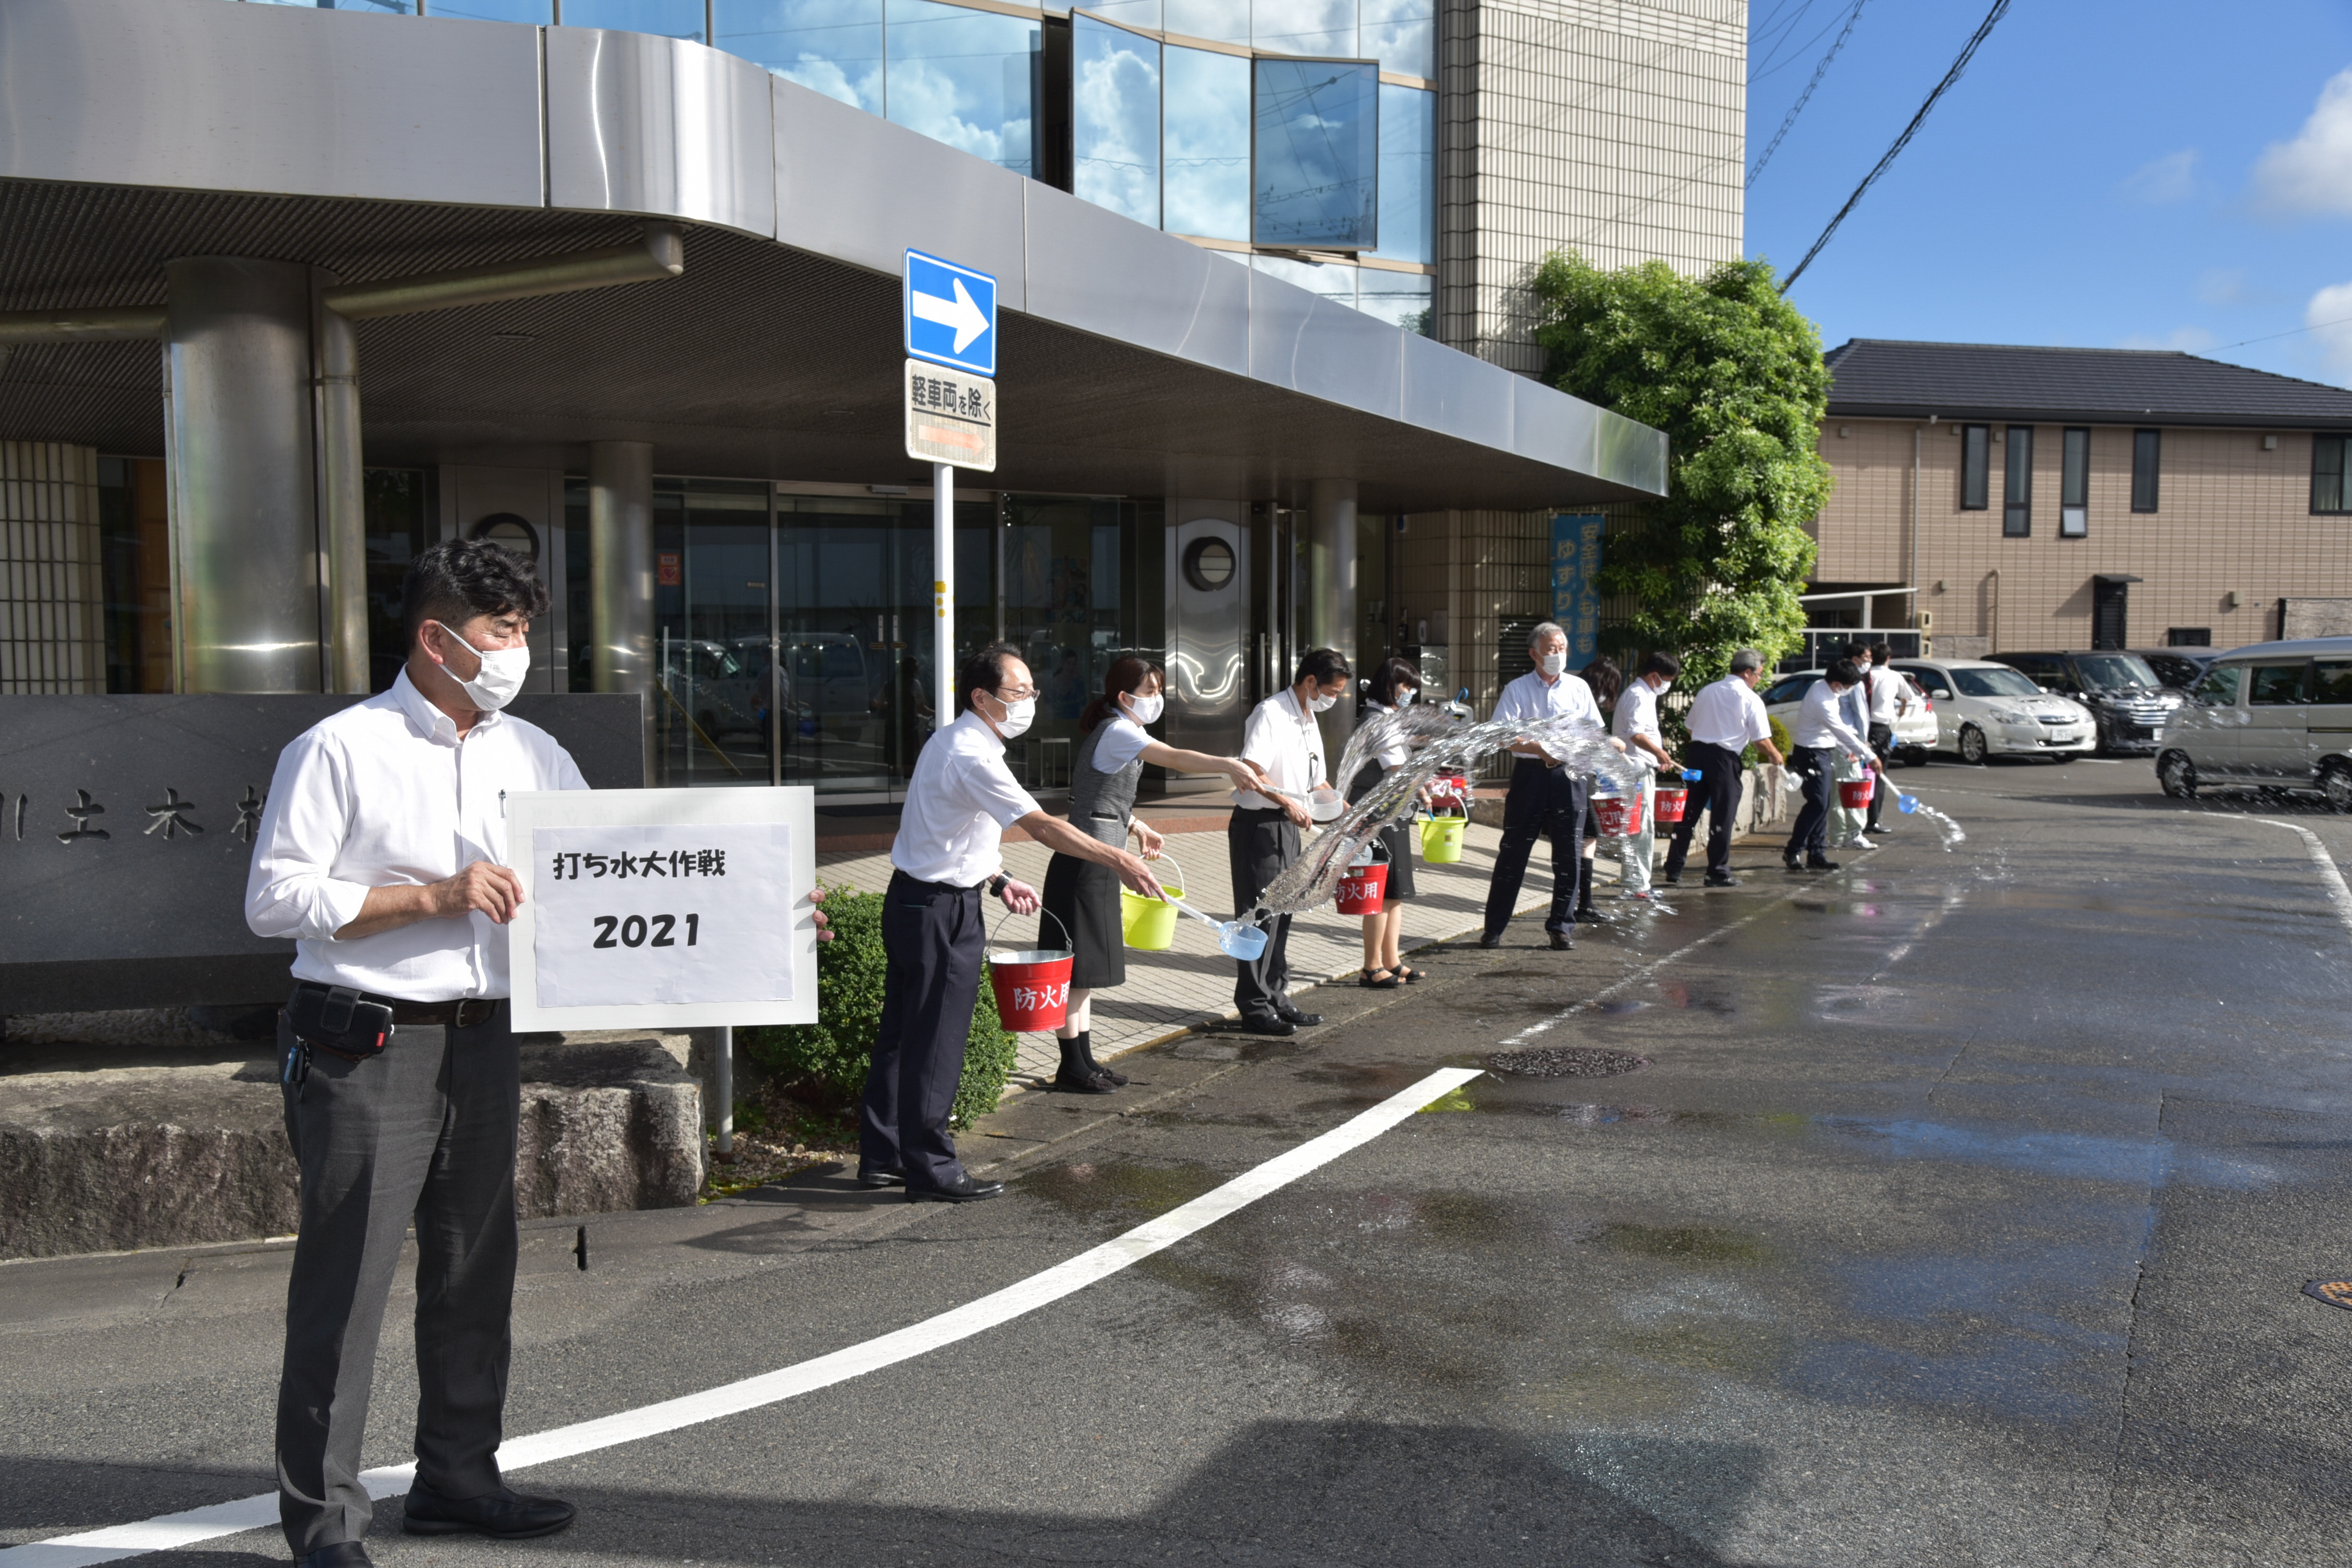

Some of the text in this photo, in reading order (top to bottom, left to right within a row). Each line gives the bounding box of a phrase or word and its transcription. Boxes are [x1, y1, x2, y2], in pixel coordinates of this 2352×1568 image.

[912, 373, 991, 421] 軽車両を除く
[1555, 539, 1576, 659] ゆずりあ
[1576, 522, 1599, 655] 安全は人も車も
[553, 849, 726, 880] 打ち水大作戦
[593, 913, 700, 949] 2021
